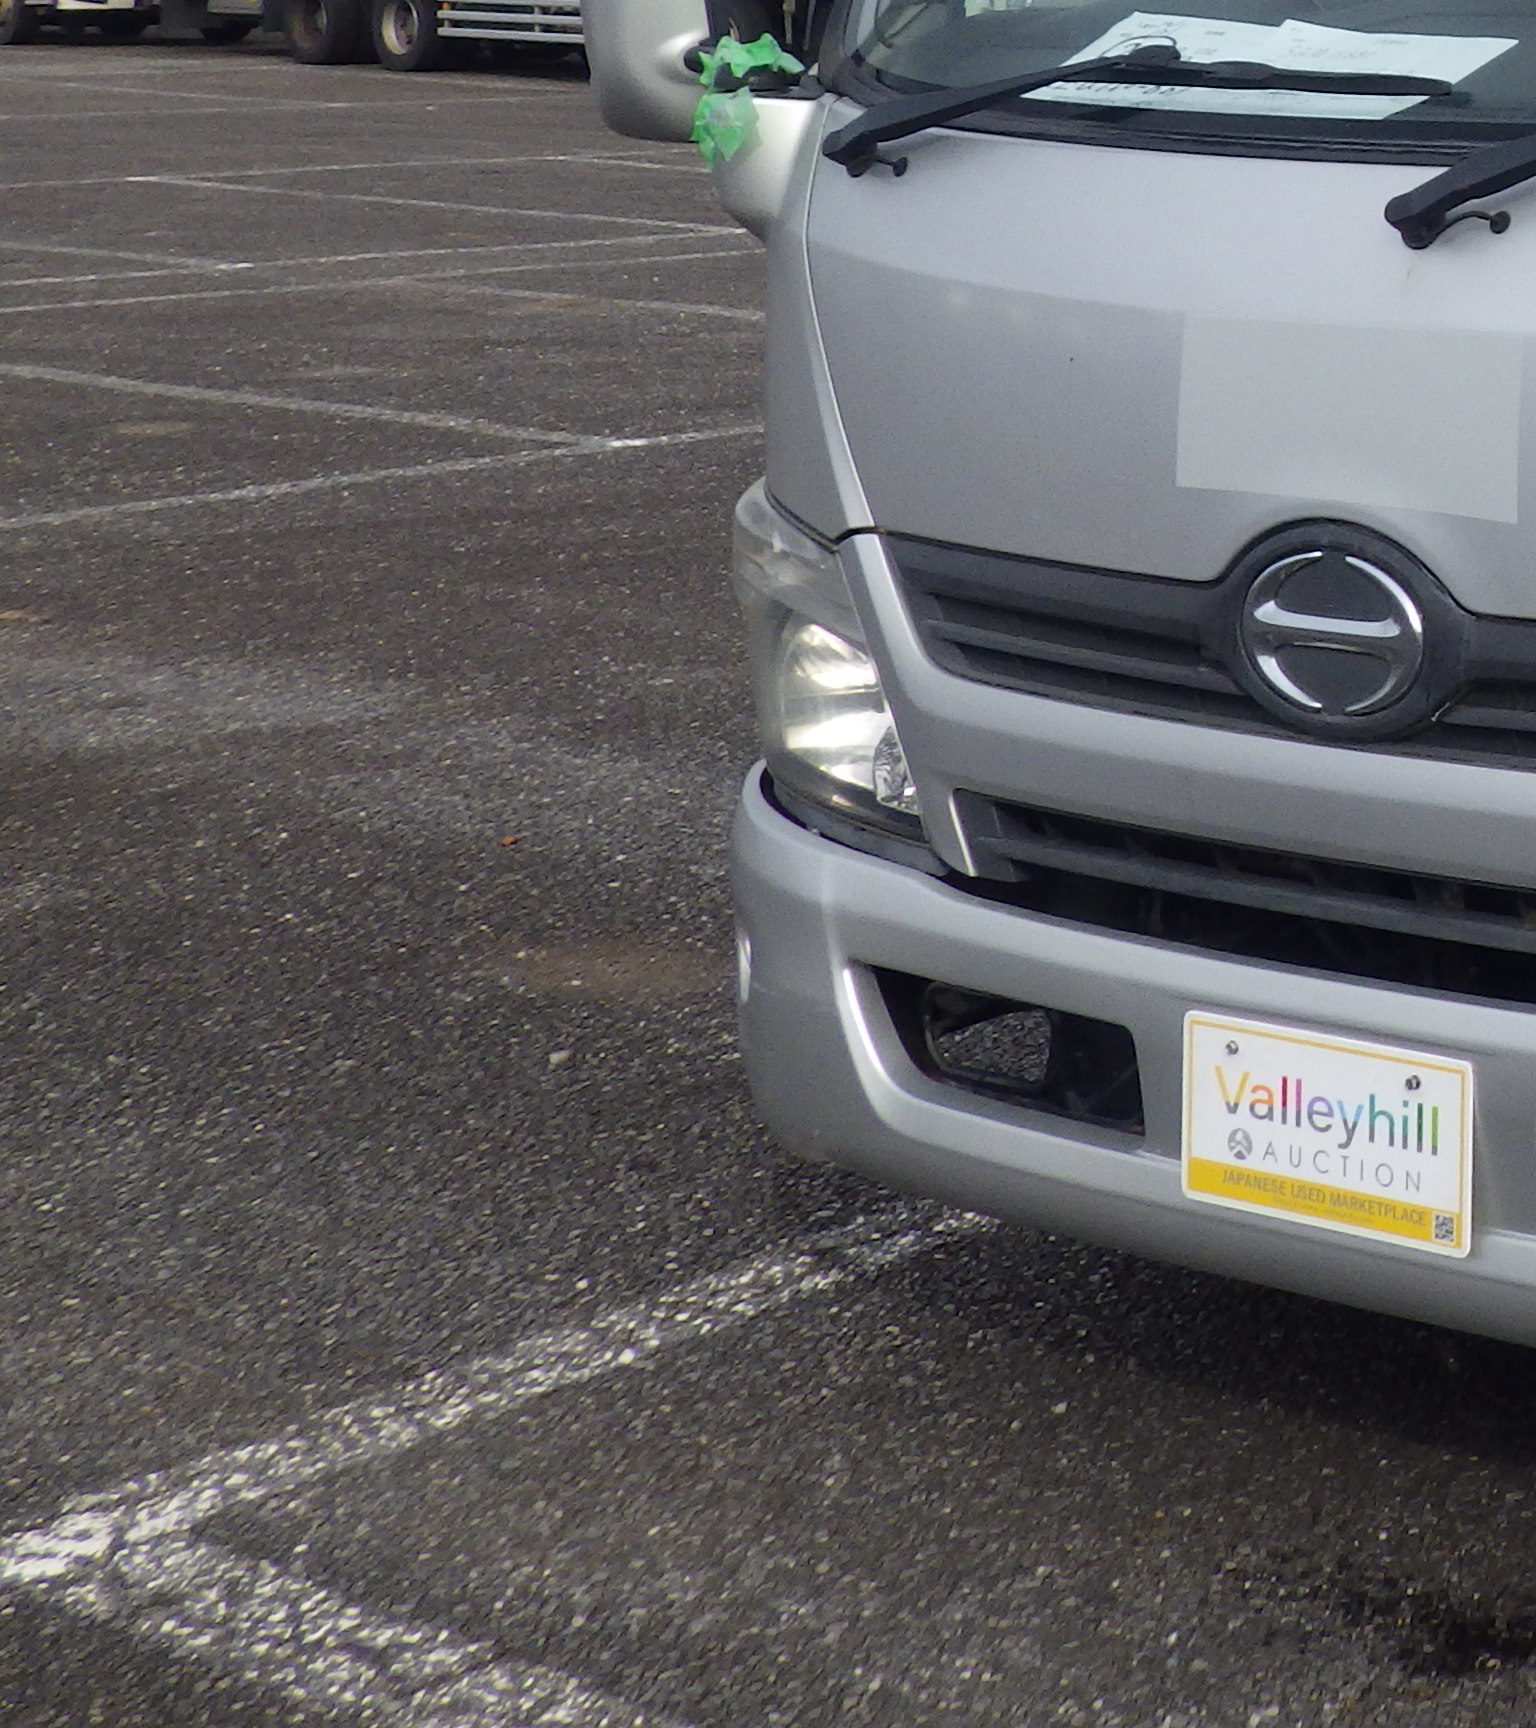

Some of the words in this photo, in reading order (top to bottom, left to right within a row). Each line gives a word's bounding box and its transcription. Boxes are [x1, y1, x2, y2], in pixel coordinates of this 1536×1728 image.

[1213, 1065, 1439, 1156] Valleyhill
[1262, 1141, 1422, 1193] AUCTION
[1222, 1169, 1286, 1197] JAPANESE
[1290, 1183, 1326, 1204] USED
[1329, 1192, 1426, 1227] MARKETPLACE
